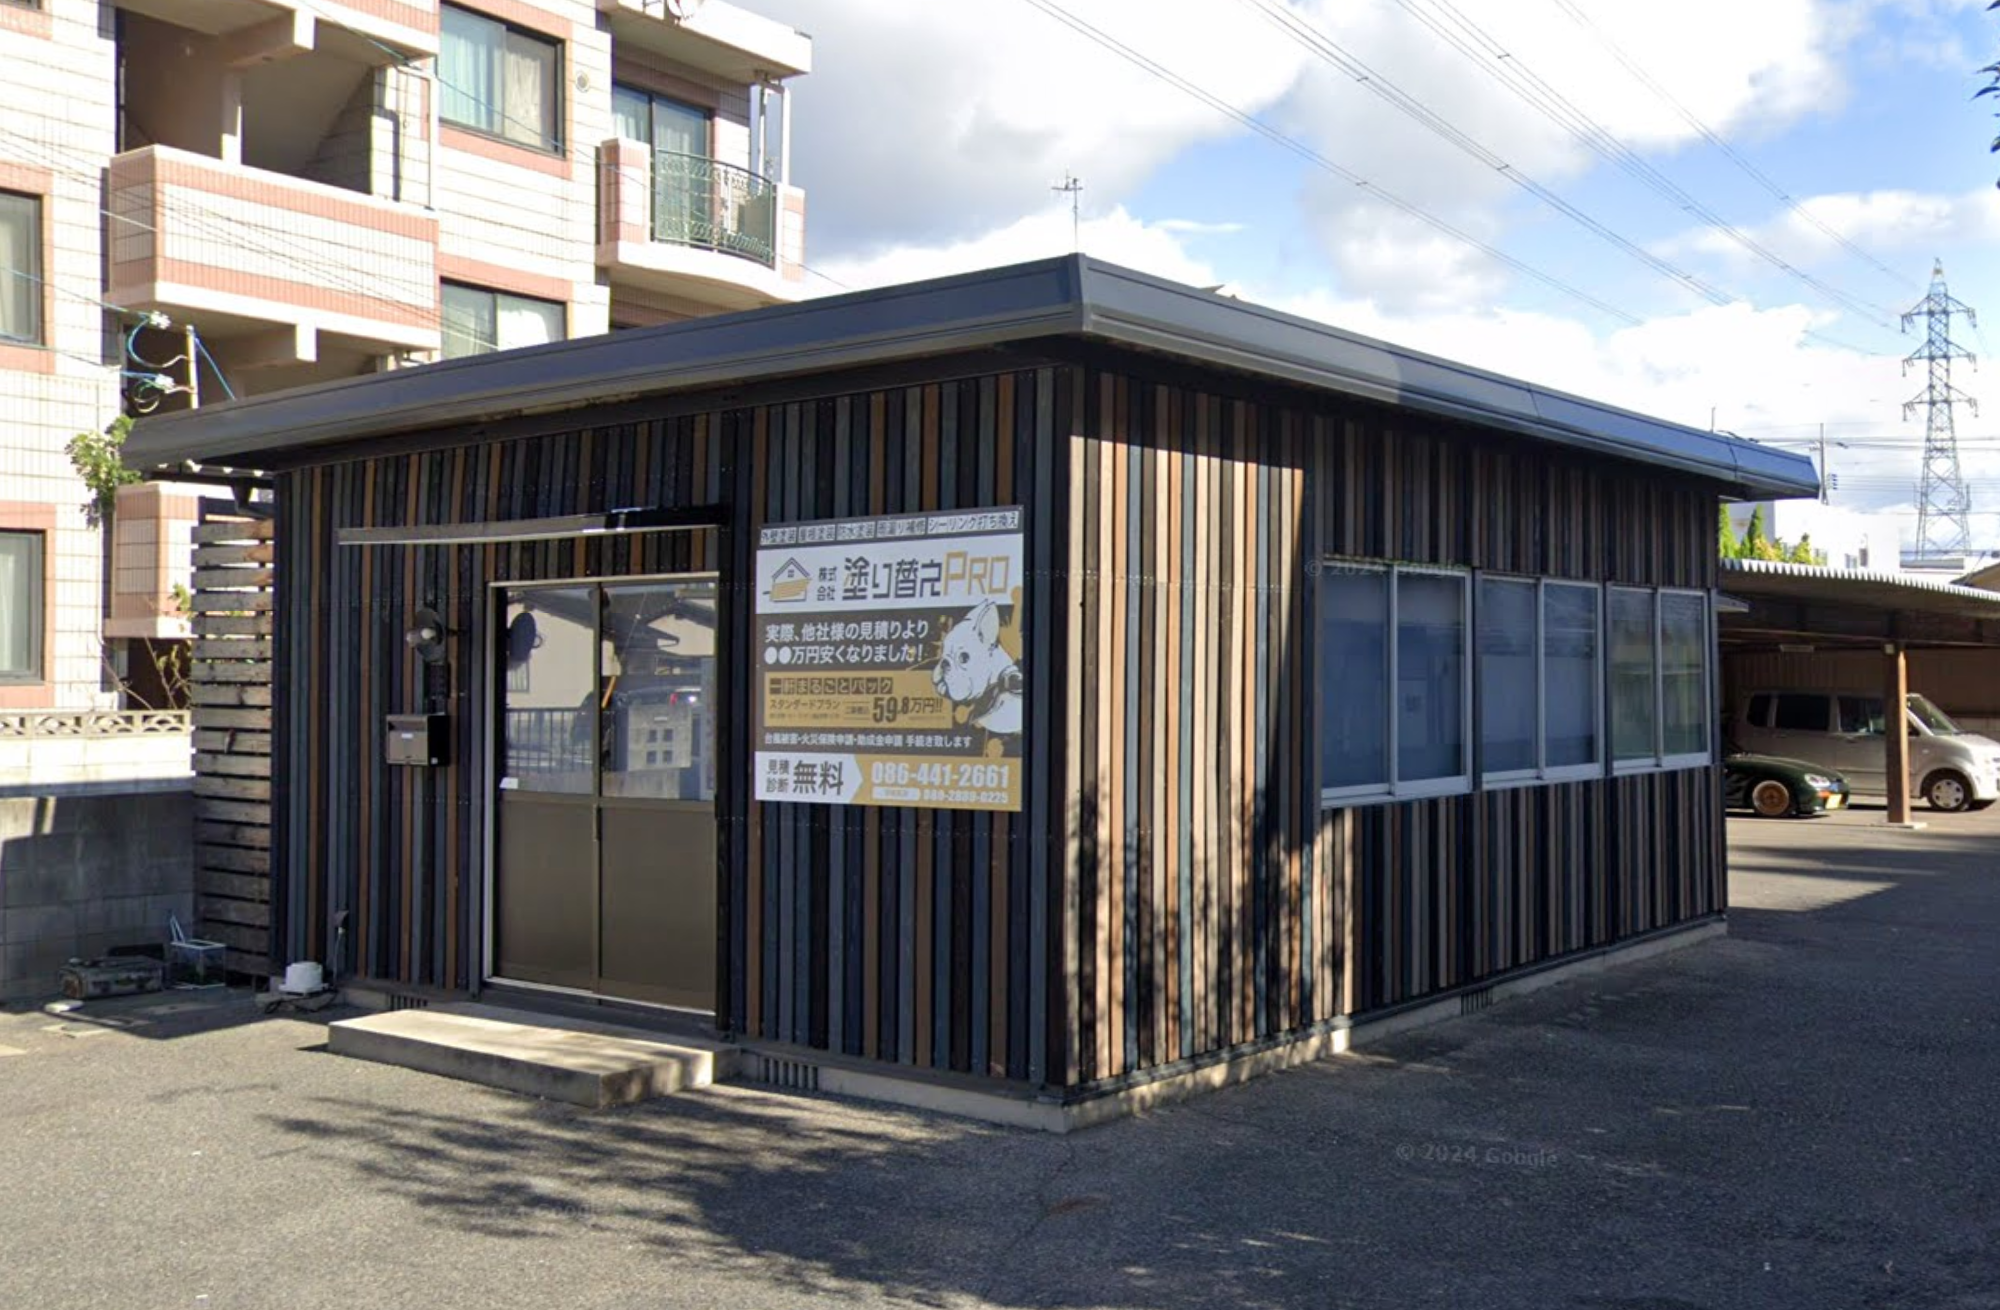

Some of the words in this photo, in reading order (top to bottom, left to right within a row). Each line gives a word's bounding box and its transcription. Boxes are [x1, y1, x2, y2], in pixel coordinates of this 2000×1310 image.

[818, 566, 837, 582] 株式
[817, 585, 836, 601] 会社
[765, 620, 929, 643] 実際、他社様の見積りより
[767, 759, 790, 775] 見積
[872, 761, 1010, 789] 086-441-2661
[766, 778, 790, 793] 診断
[793, 760, 844, 796] 無料
